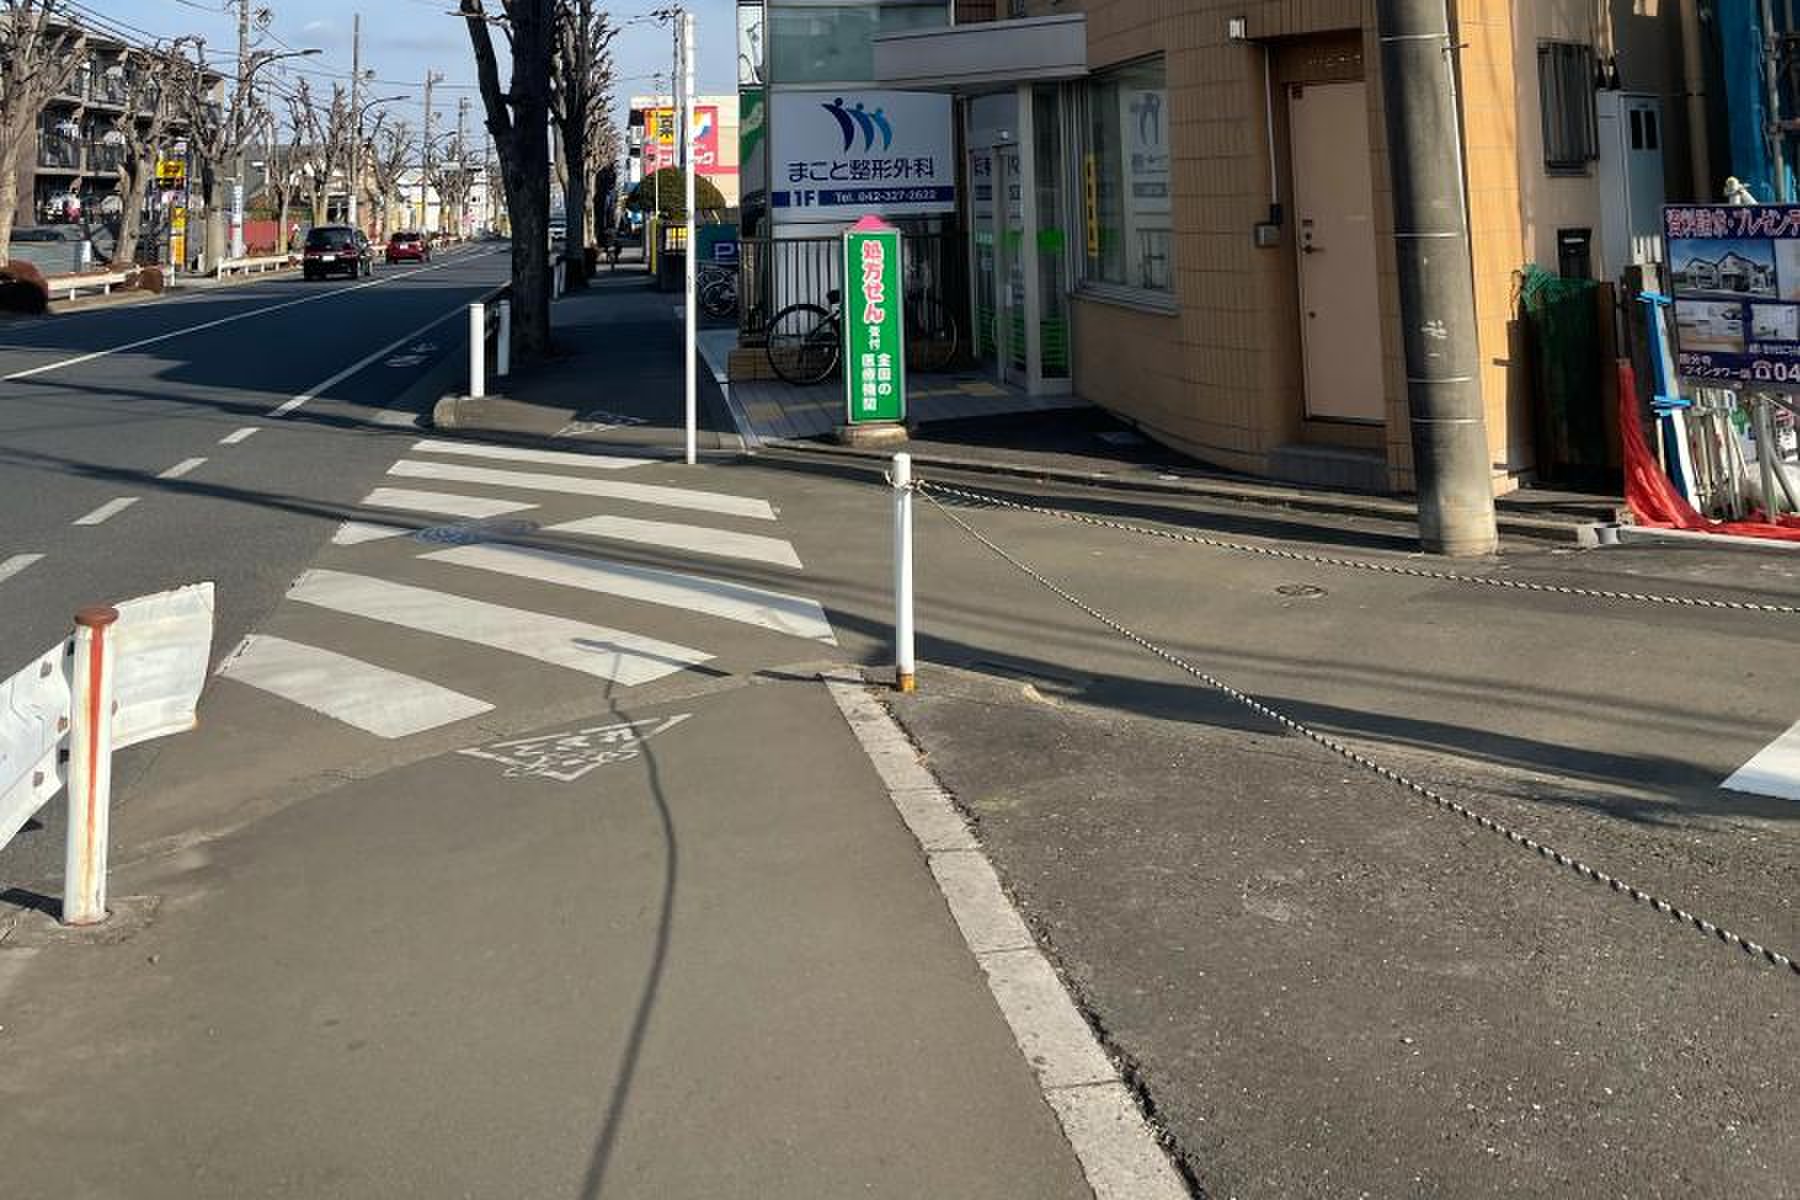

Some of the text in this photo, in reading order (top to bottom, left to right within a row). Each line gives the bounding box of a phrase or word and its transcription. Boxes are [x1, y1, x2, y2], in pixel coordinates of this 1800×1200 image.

[788, 157, 934, 183] まこと整形外科
[793, 190, 815, 207] 1F
